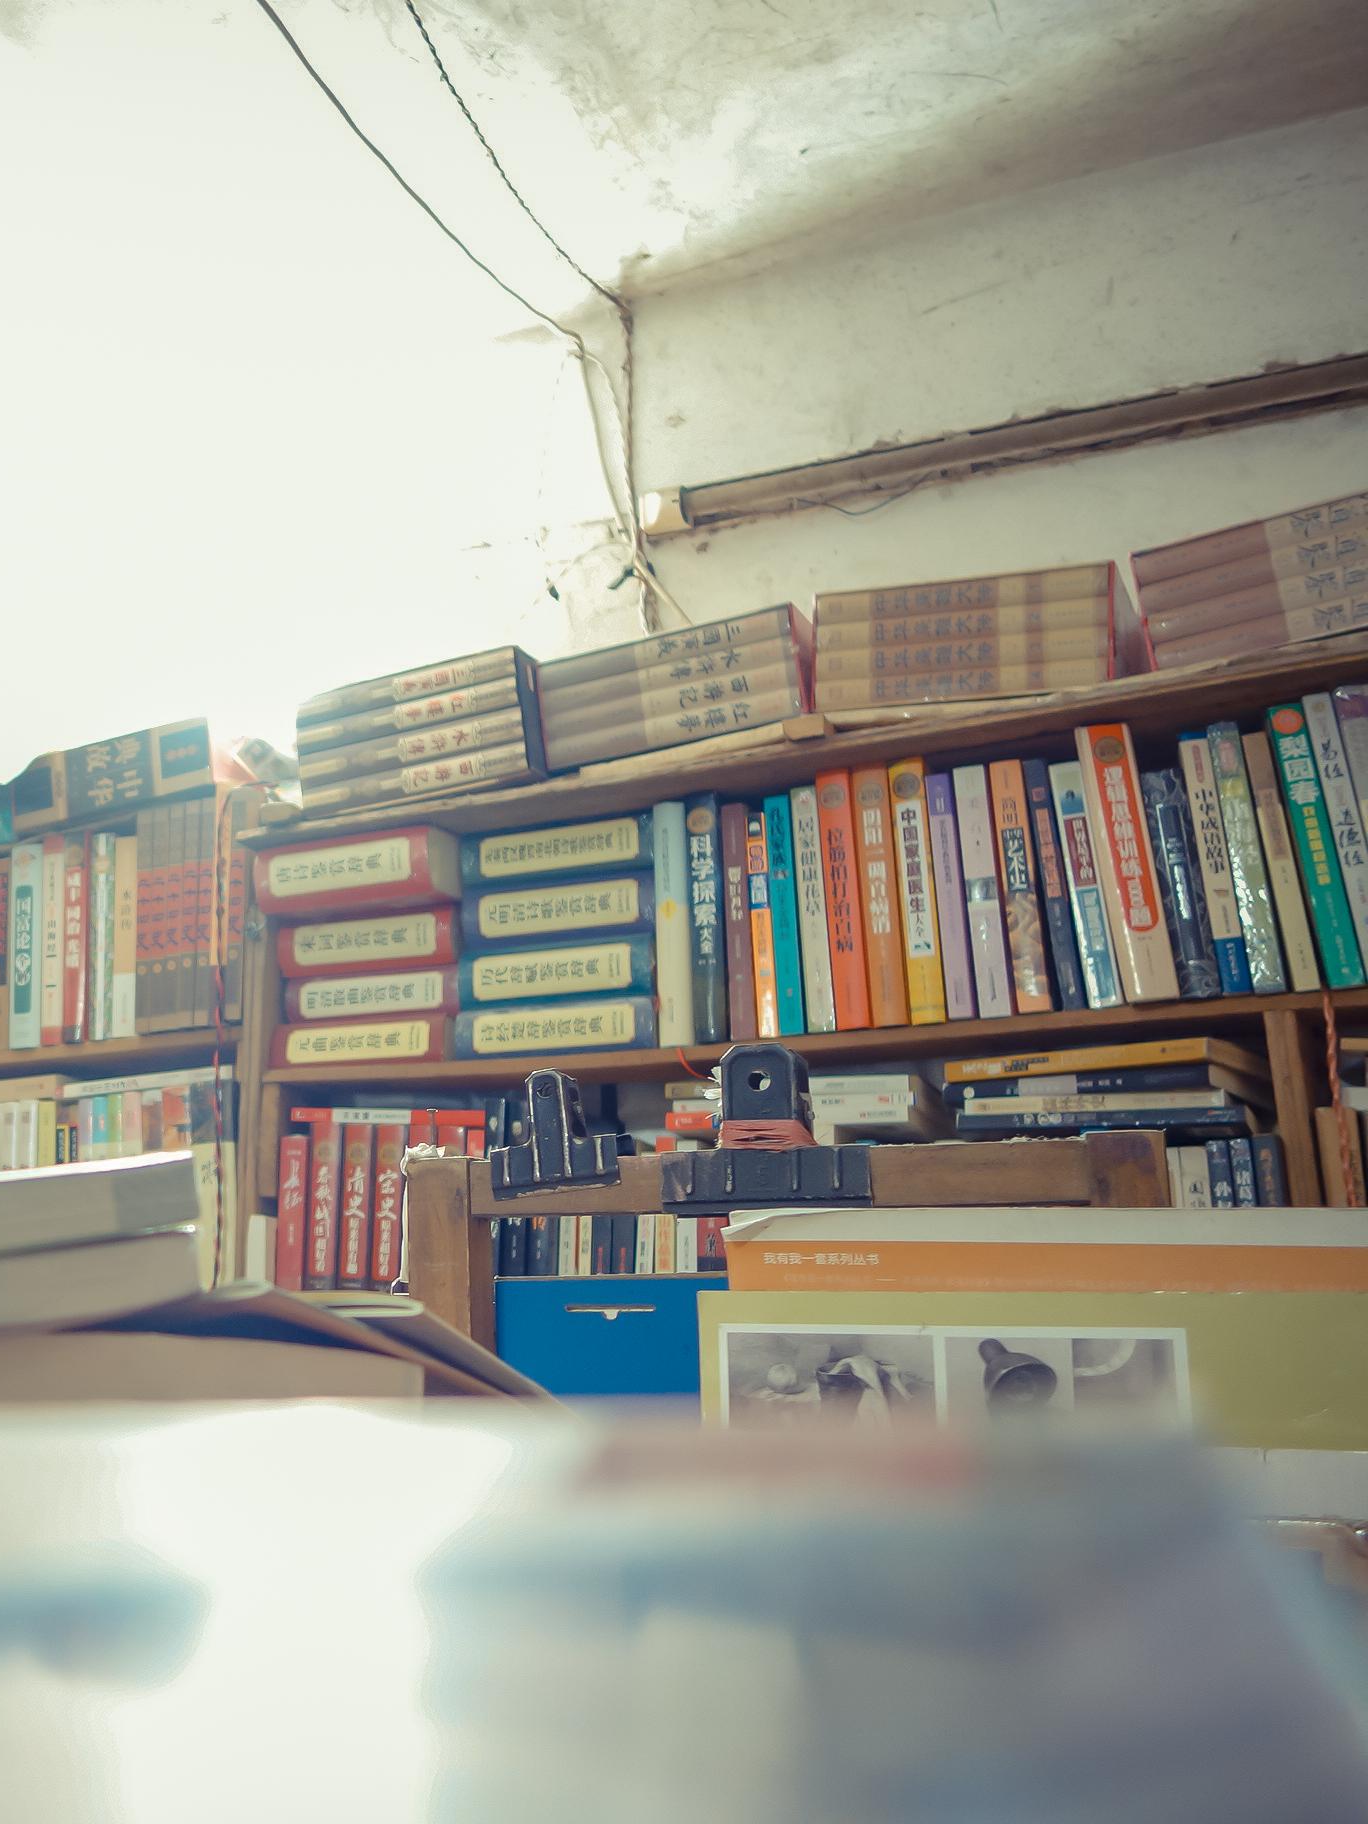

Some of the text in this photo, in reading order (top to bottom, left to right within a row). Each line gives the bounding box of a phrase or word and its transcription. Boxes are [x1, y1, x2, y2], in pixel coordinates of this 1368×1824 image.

[763, 1251, 880, 1267] 我有我一套系列丛书
